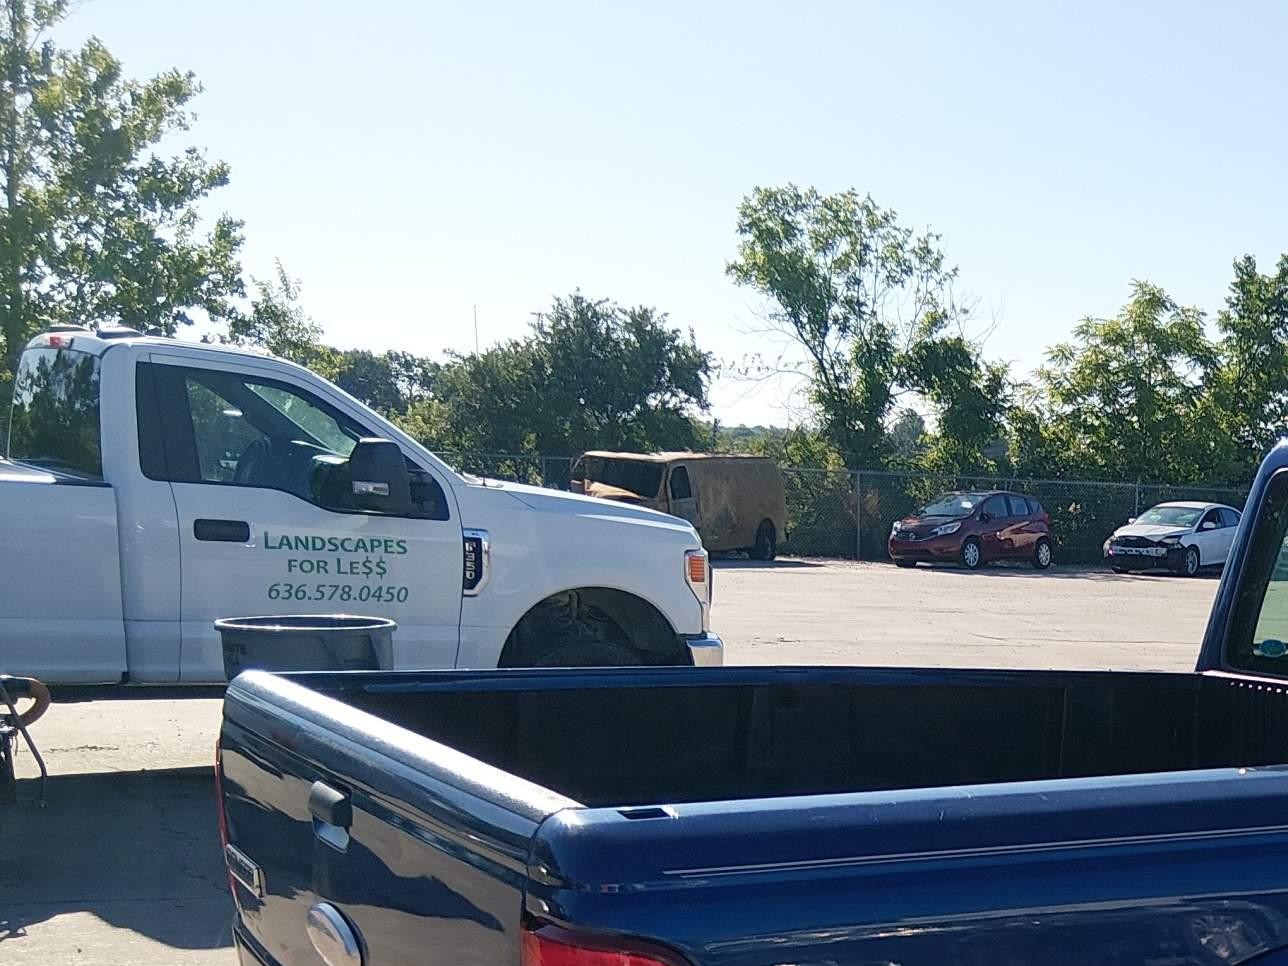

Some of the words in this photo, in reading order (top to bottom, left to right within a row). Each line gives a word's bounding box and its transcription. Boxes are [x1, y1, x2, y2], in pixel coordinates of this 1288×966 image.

[264, 531, 408, 554] LANDSCAPES
[287, 558, 328, 574] FOR
[268, 583, 409, 603] 636.578.0450
